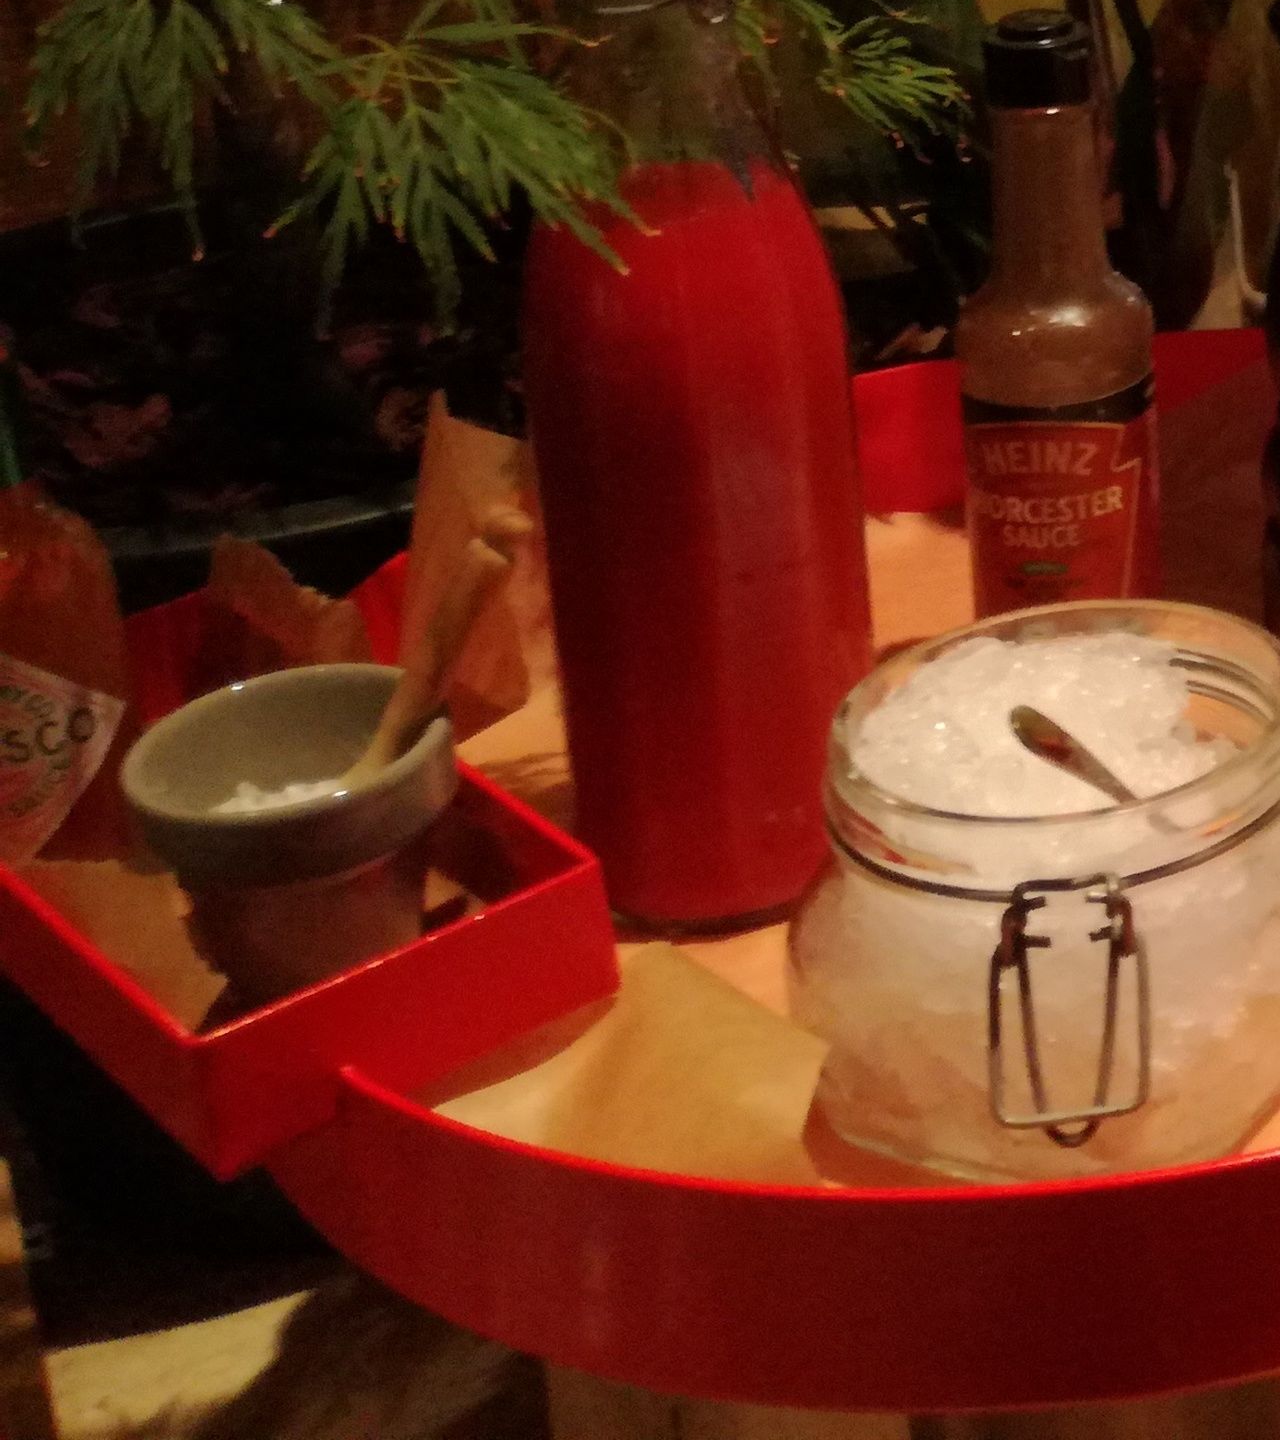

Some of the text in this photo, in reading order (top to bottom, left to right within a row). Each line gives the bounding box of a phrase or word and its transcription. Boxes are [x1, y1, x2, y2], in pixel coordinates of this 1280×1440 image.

[981, 441, 1098, 476] HEINZ
[1002, 523, 1082, 549] SAUCE
[0, 706, 97, 763] SCO
